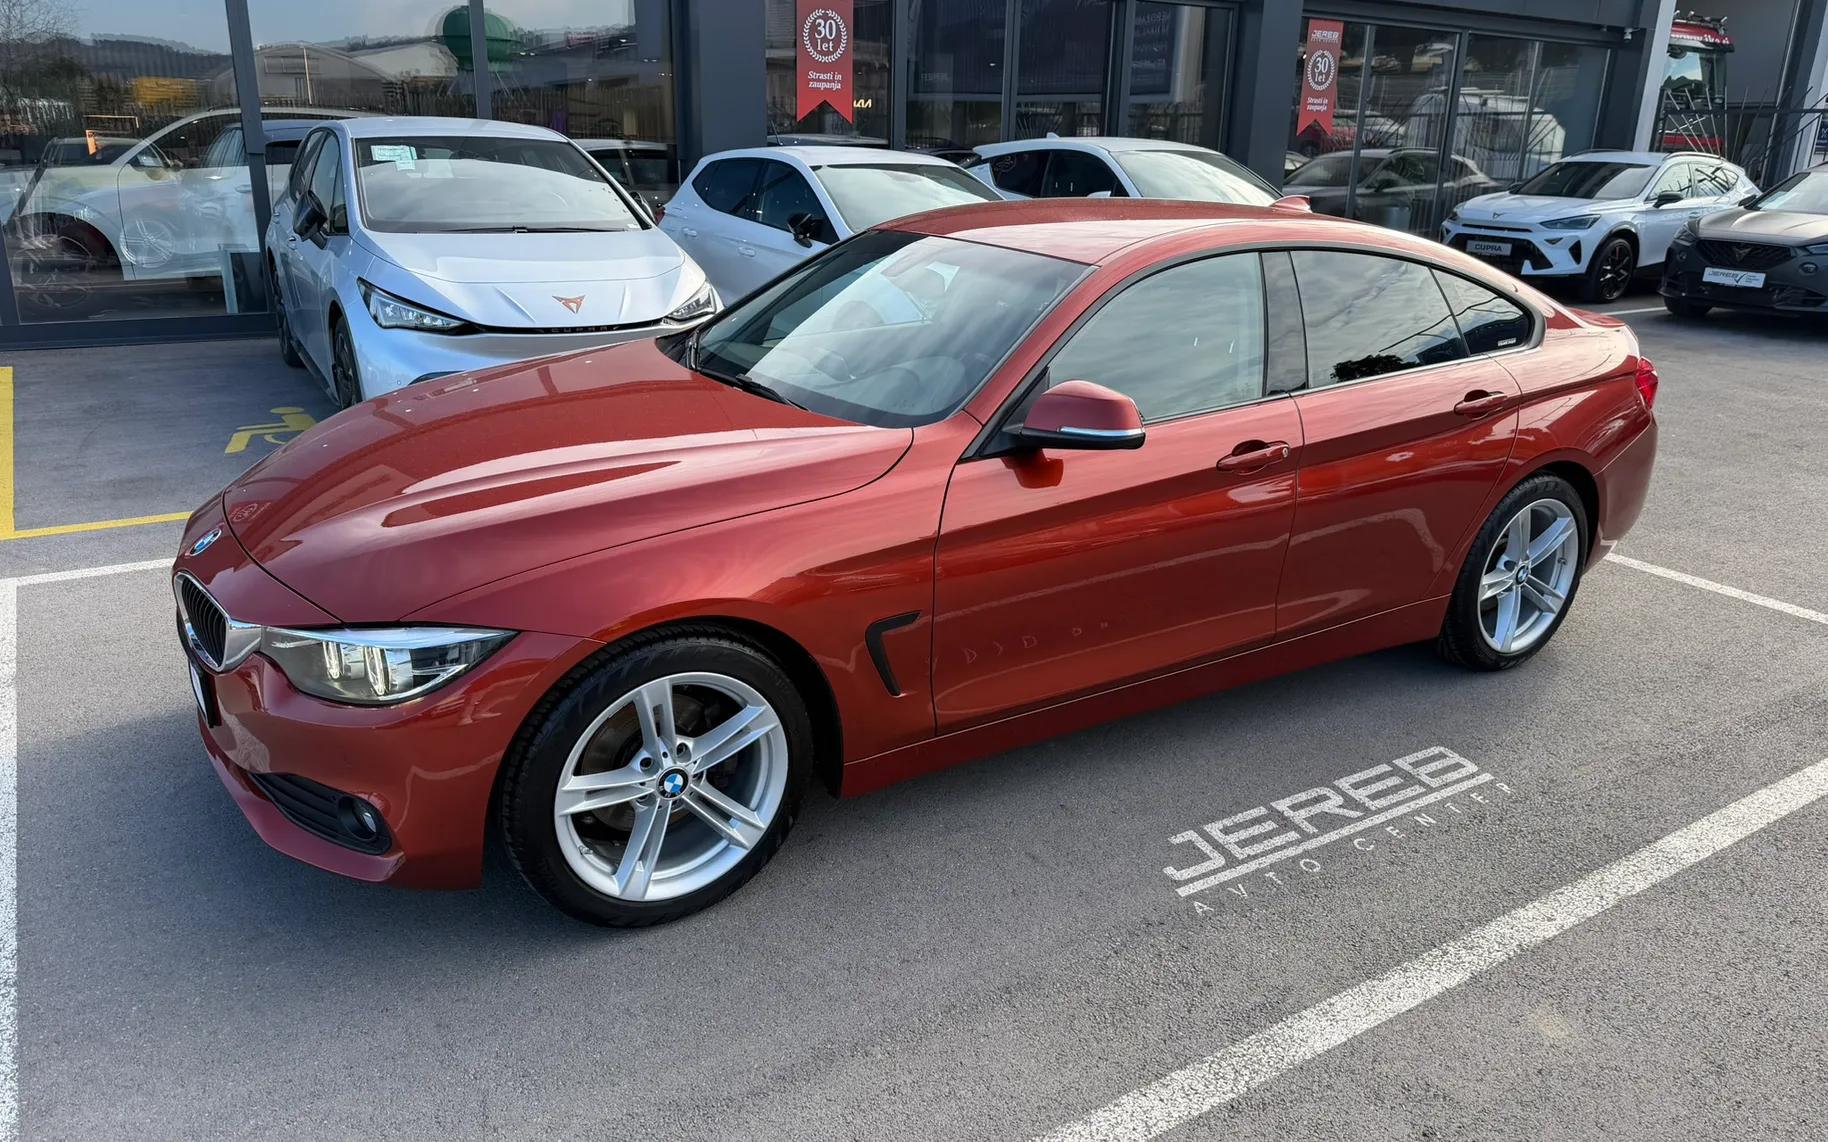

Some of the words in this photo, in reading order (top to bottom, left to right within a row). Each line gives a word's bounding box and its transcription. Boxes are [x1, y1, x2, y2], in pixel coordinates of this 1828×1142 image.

[815, 19, 836, 39] 30
[1312, 30, 1339, 39] JEREB
[817, 39, 834, 51] let
[1314, 57, 1329, 73] 30
[808, 71, 834, 80] Strasti
[834, 72, 842, 81] in
[1314, 72, 1326, 82] let
[808, 80, 841, 91] zaupanja
[1475, 243, 1503, 252] CUPRA
[1708, 270, 1739, 279] JEREB
[551, 325, 608, 334] CUPRA
[1163, 745, 1480, 882] JEREB
[1193, 857, 1322, 916] AVTO
[1353, 781, 1513, 852] CENTER
